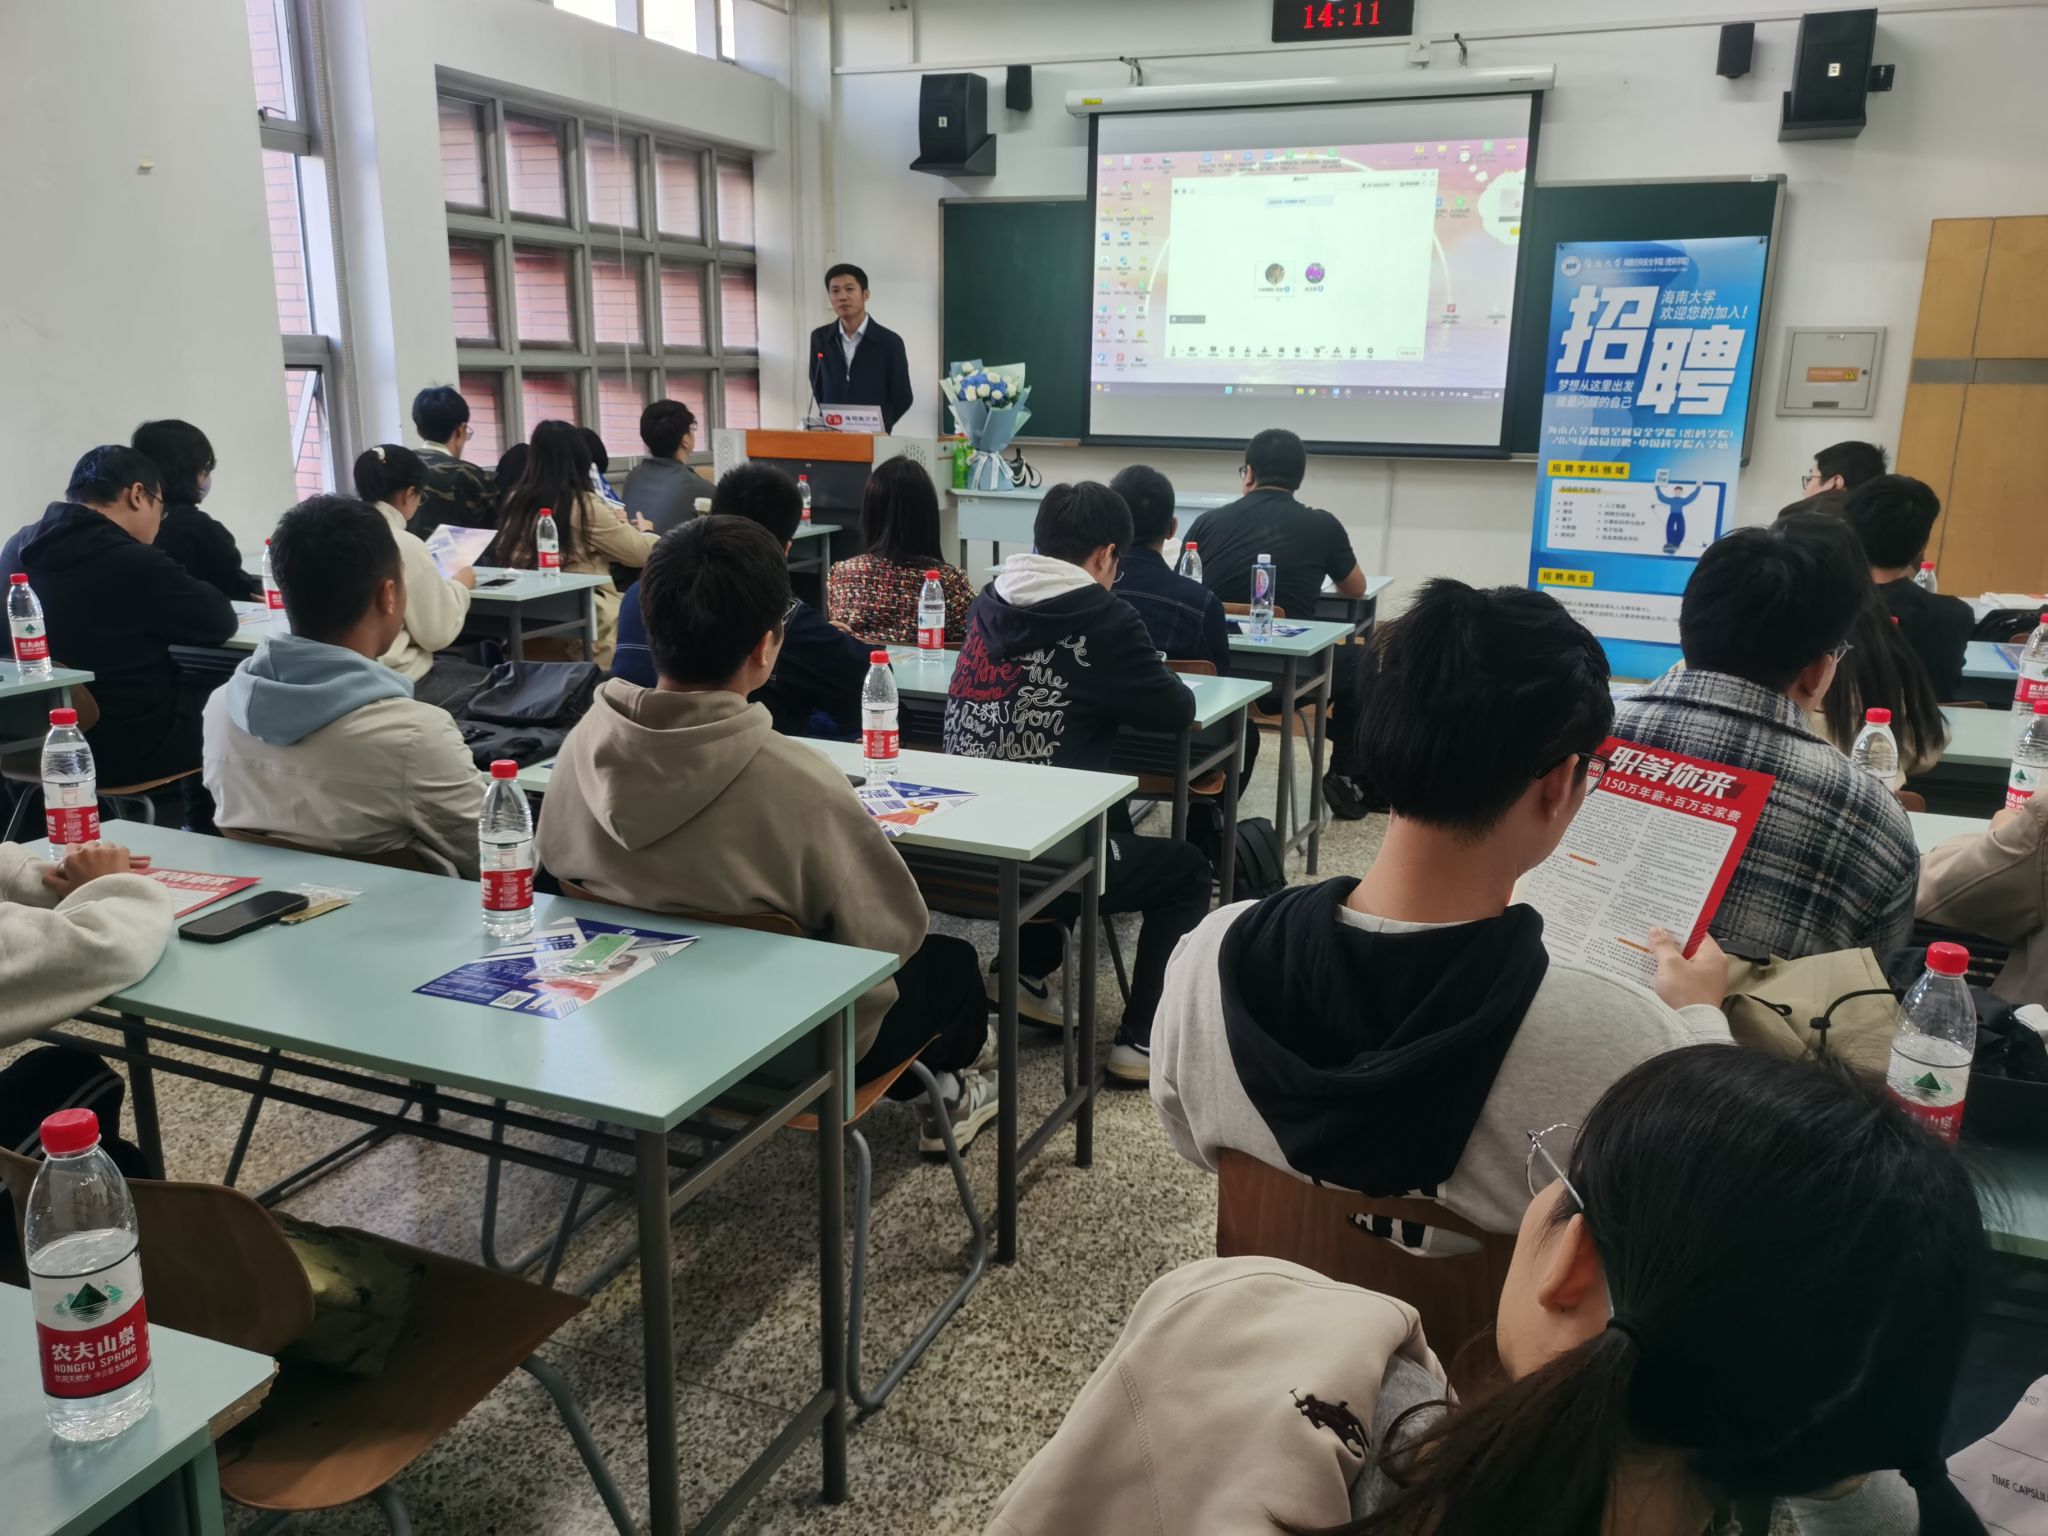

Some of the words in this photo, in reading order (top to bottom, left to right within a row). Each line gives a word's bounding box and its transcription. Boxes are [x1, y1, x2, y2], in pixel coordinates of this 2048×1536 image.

[1304, 1, 1380, 29] 14:11
[1661, 289, 1716, 305] 海南大学
[1555, 284, 1746, 415] 招聘
[1557, 379, 1635, 393] 梦想从这里出发
[1552, 463, 1626, 476] 招聘学科领域
[1543, 571, 1589, 584] 招聘岗位
[1608, 746, 1738, 799] 职等你来
[51, 1326, 136, 1362] 农夫山泉
[54, 1361, 96, 1373] NONGFU
[100, 1344, 137, 1367] SPRING
[1991, 1473, 2011, 1490] TIME
